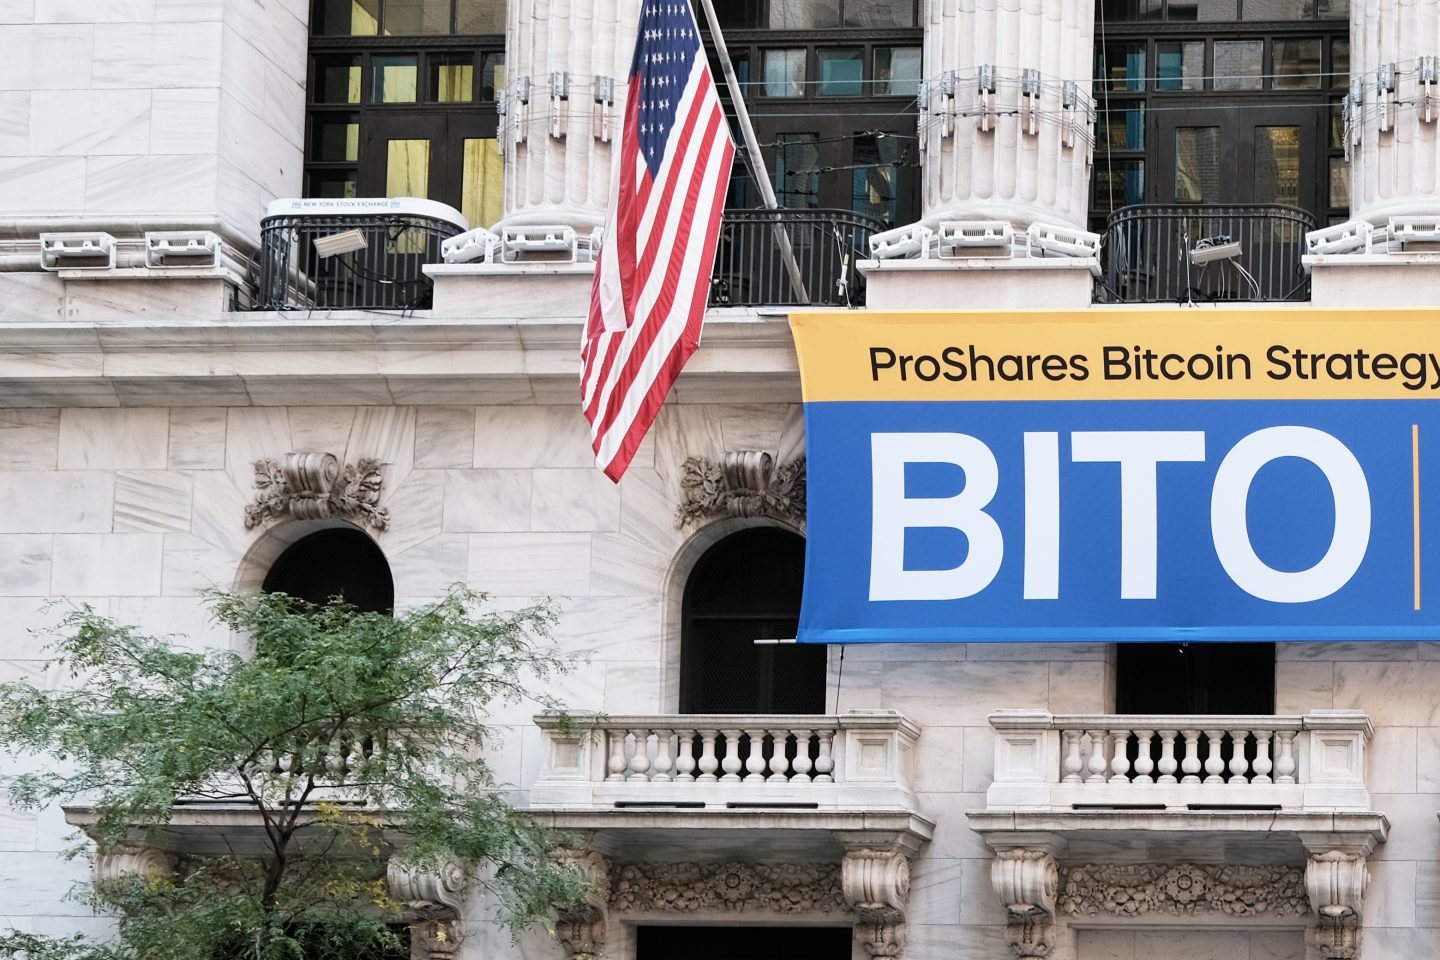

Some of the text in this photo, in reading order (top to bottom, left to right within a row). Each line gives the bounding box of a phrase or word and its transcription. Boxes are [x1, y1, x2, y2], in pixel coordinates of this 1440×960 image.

[869, 344, 1090, 382] ProShares
[1102, 344, 1252, 382] Bitcoin
[868, 425, 1372, 604] BITO
